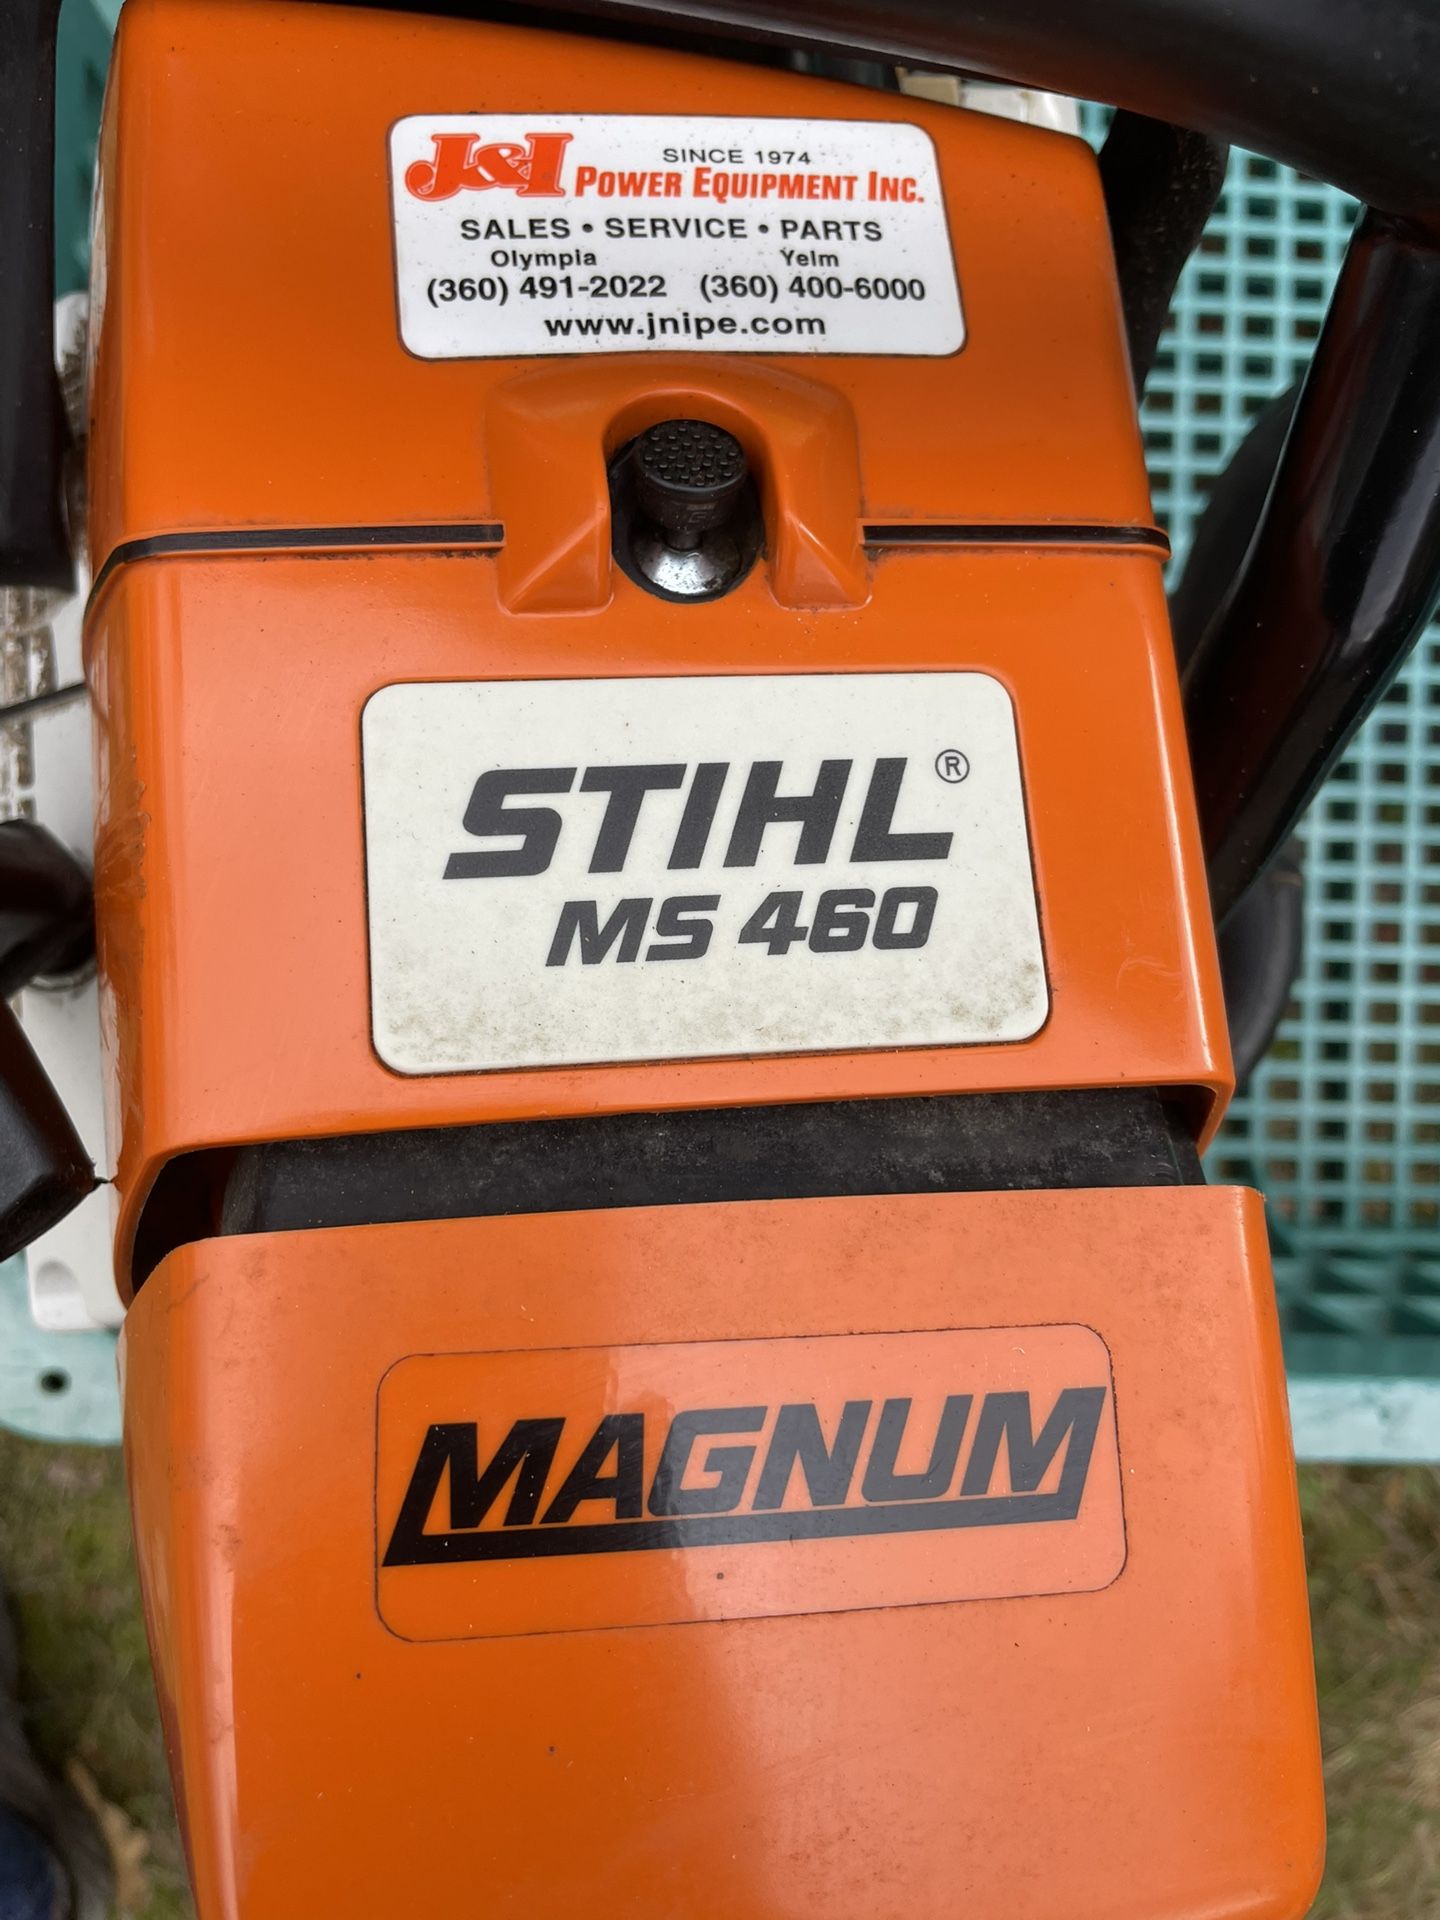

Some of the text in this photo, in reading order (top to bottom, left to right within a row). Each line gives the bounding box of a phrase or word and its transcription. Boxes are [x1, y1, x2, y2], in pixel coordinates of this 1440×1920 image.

[663, 148, 811, 166] SINCE 1974
[575, 166, 925, 203] POWER EQUIPMENT INC.
[460, 218, 883, 242] SALES SERVICE PARTS
[491, 249, 597, 270] Olympia
[780, 249, 840, 268] Yelm
[426, 275, 667, 307] (360) 491-2022
[699, 275, 926, 303] (360) 400-6000
[544, 313, 826, 340] www.jnipe.com
[442, 757, 954, 879] STIHL
[545, 886, 939, 967] MS 460
[382, 1386, 1108, 1567] MAGNUM
